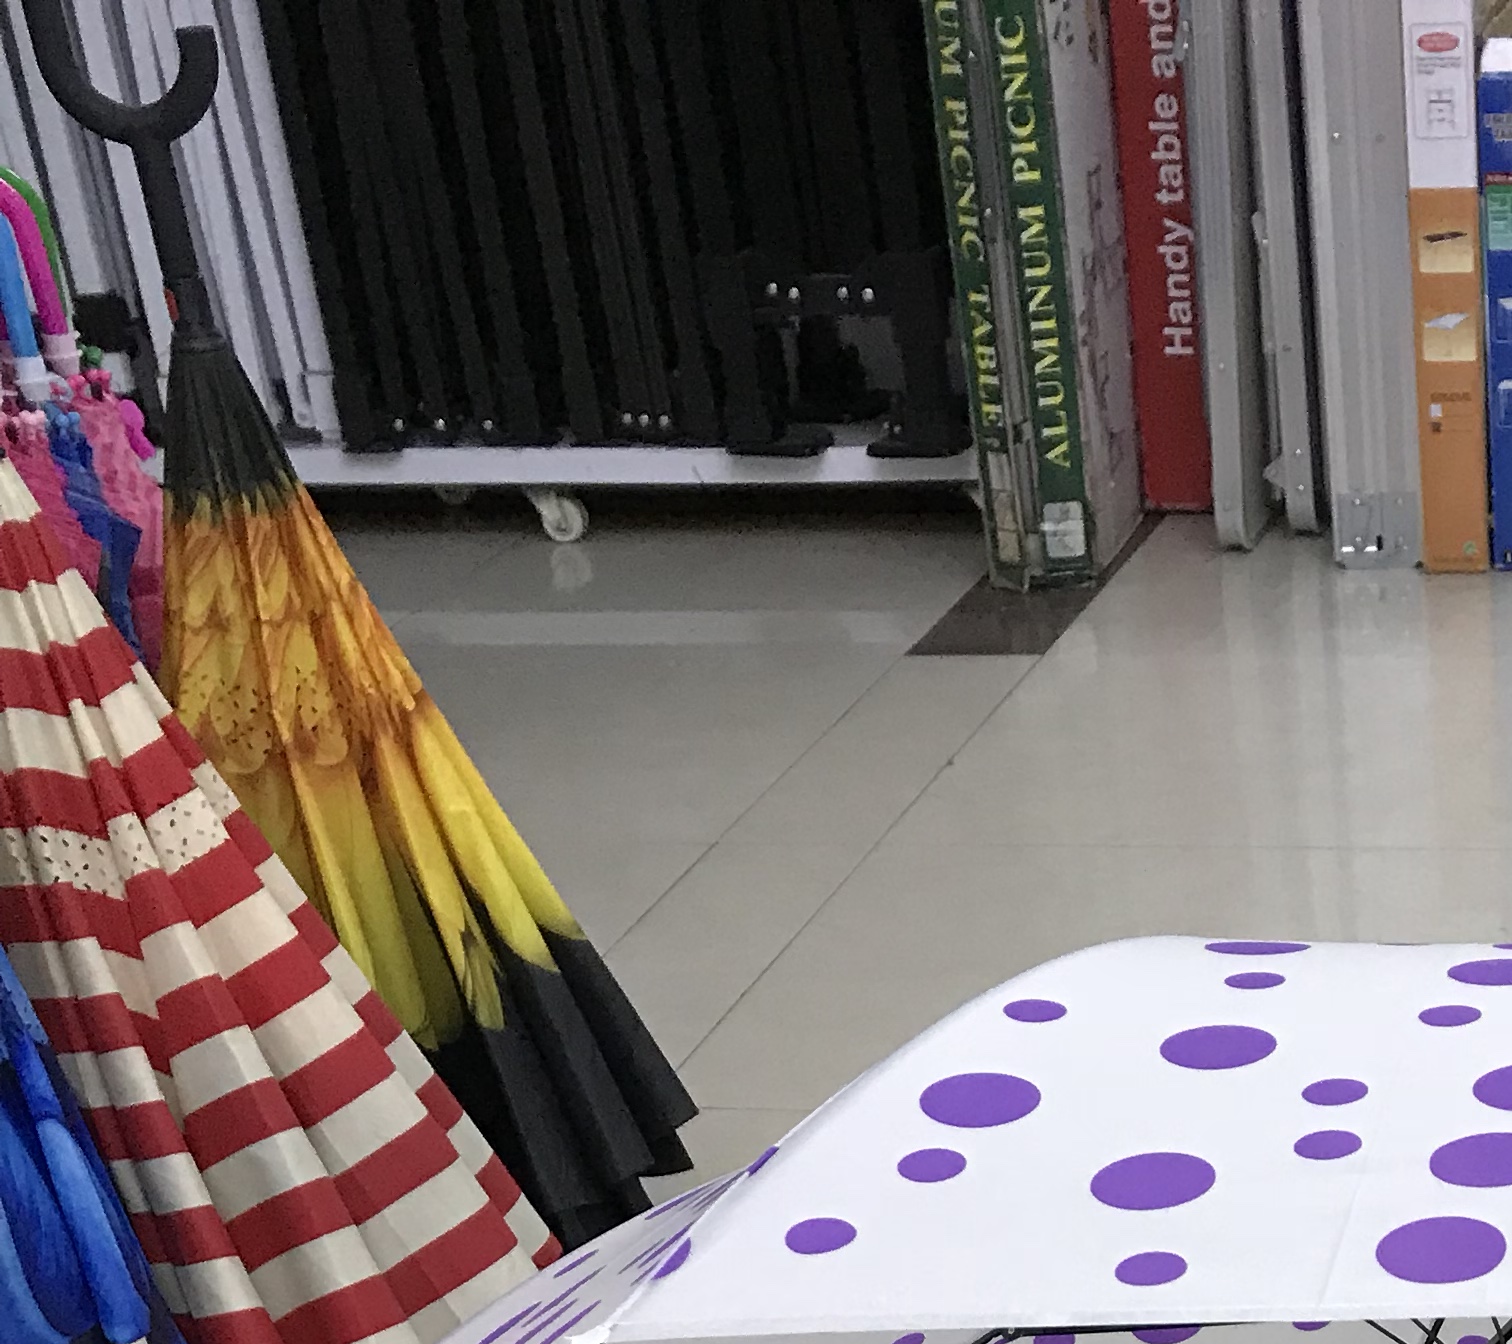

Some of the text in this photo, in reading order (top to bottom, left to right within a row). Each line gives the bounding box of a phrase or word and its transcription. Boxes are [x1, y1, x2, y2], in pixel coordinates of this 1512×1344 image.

[944, 97, 985, 262] PICNIC
[968, 284, 1003, 428] TABLE
[994, 14, 1072, 469] ALUMINUM PICNIC
[1138, 0, 1195, 356] Handy table and
